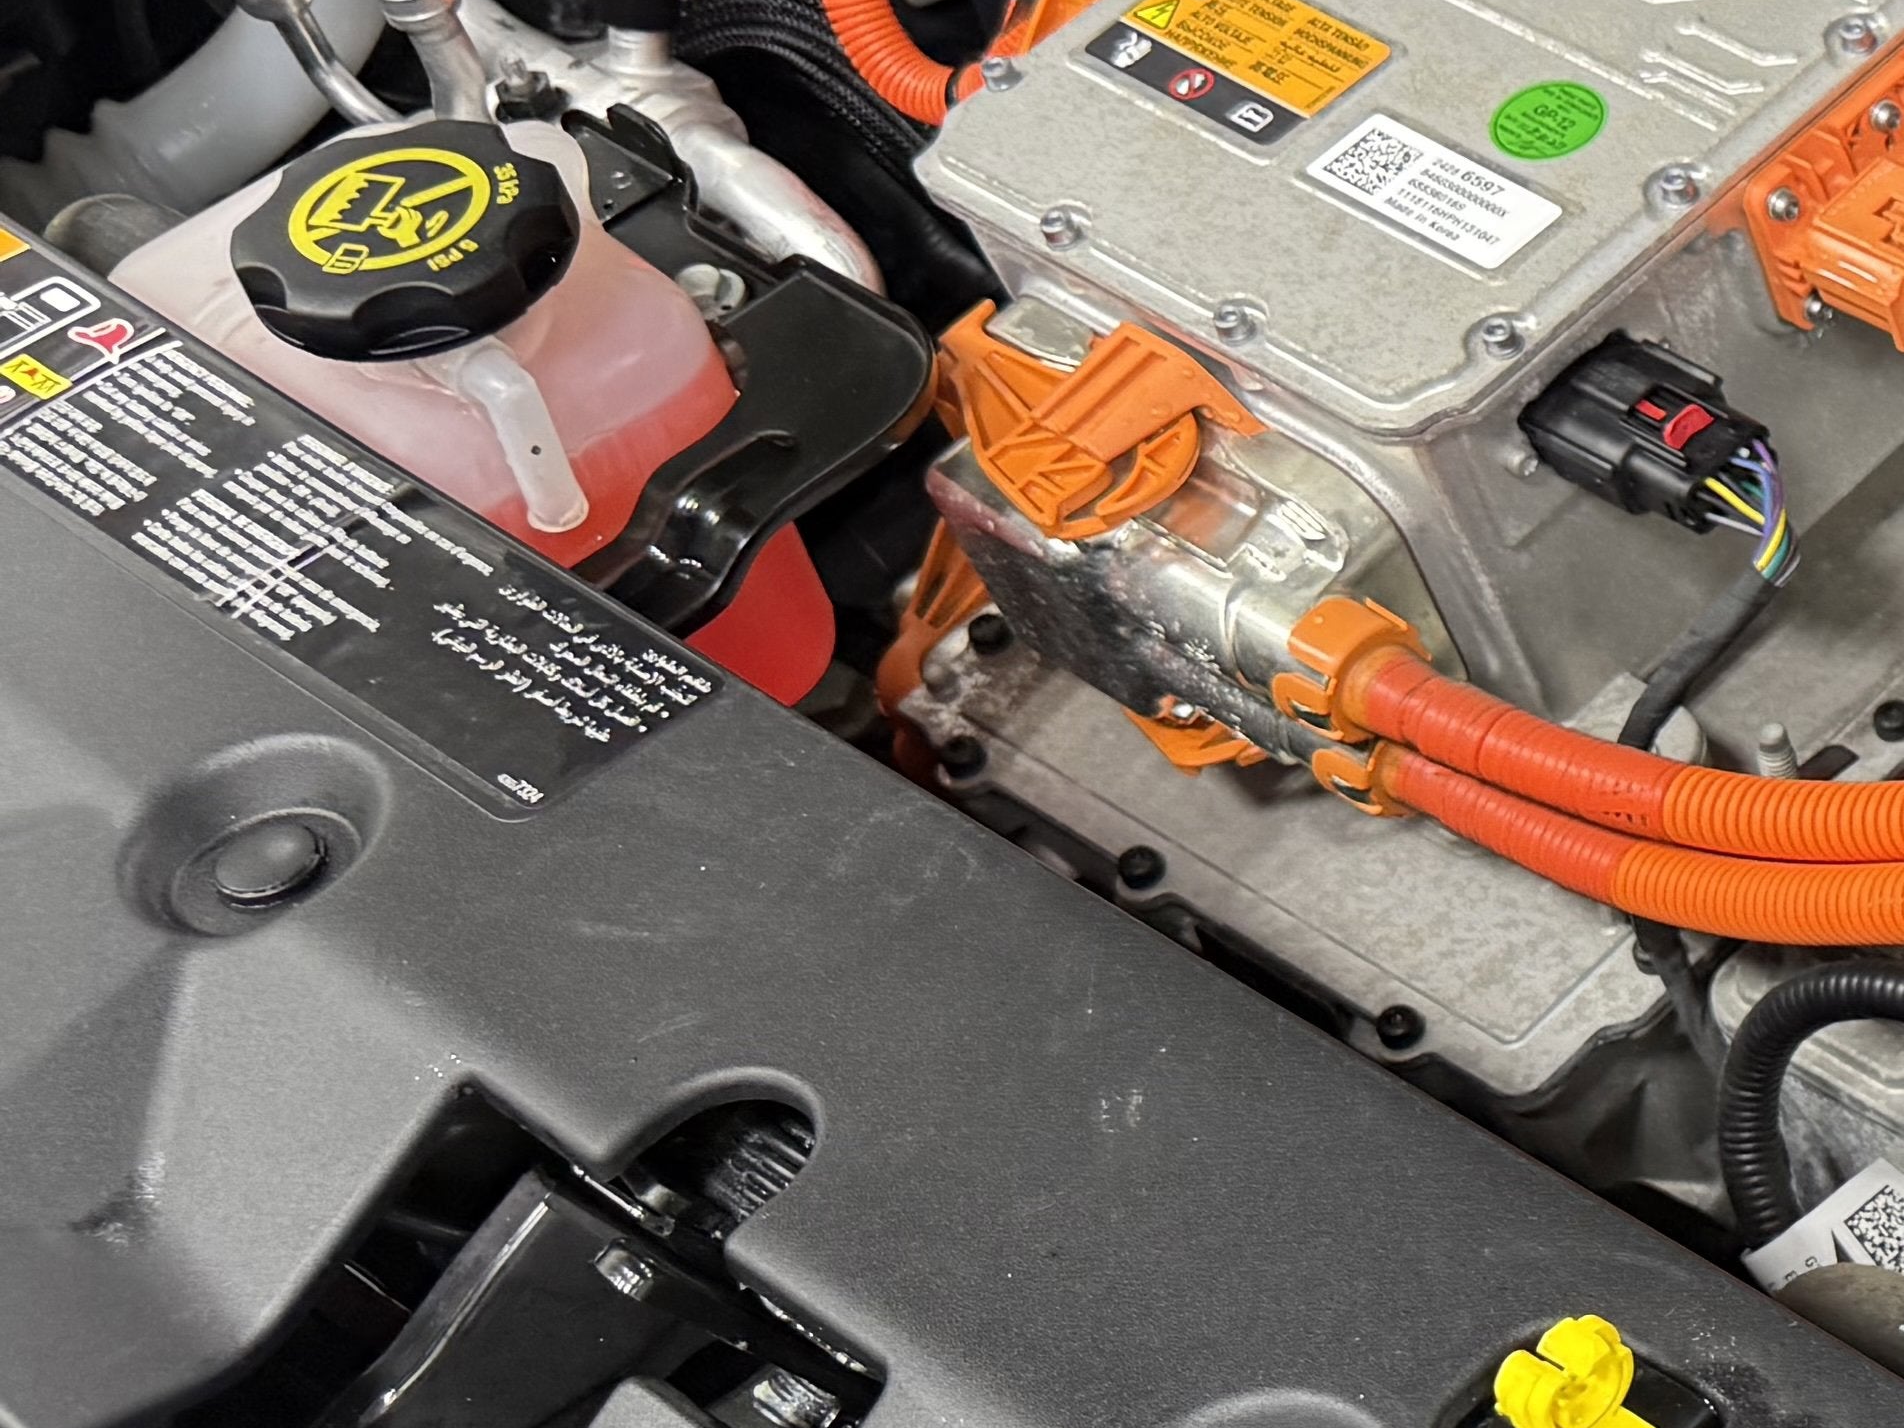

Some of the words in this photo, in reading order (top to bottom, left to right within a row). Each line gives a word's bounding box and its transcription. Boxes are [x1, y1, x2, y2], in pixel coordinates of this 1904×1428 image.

[1459, 169, 1505, 197] 6597
[1382, 197, 1415, 216] Made
[1413, 212, 1429, 223] in
[1426, 220, 1461, 241] Korea
